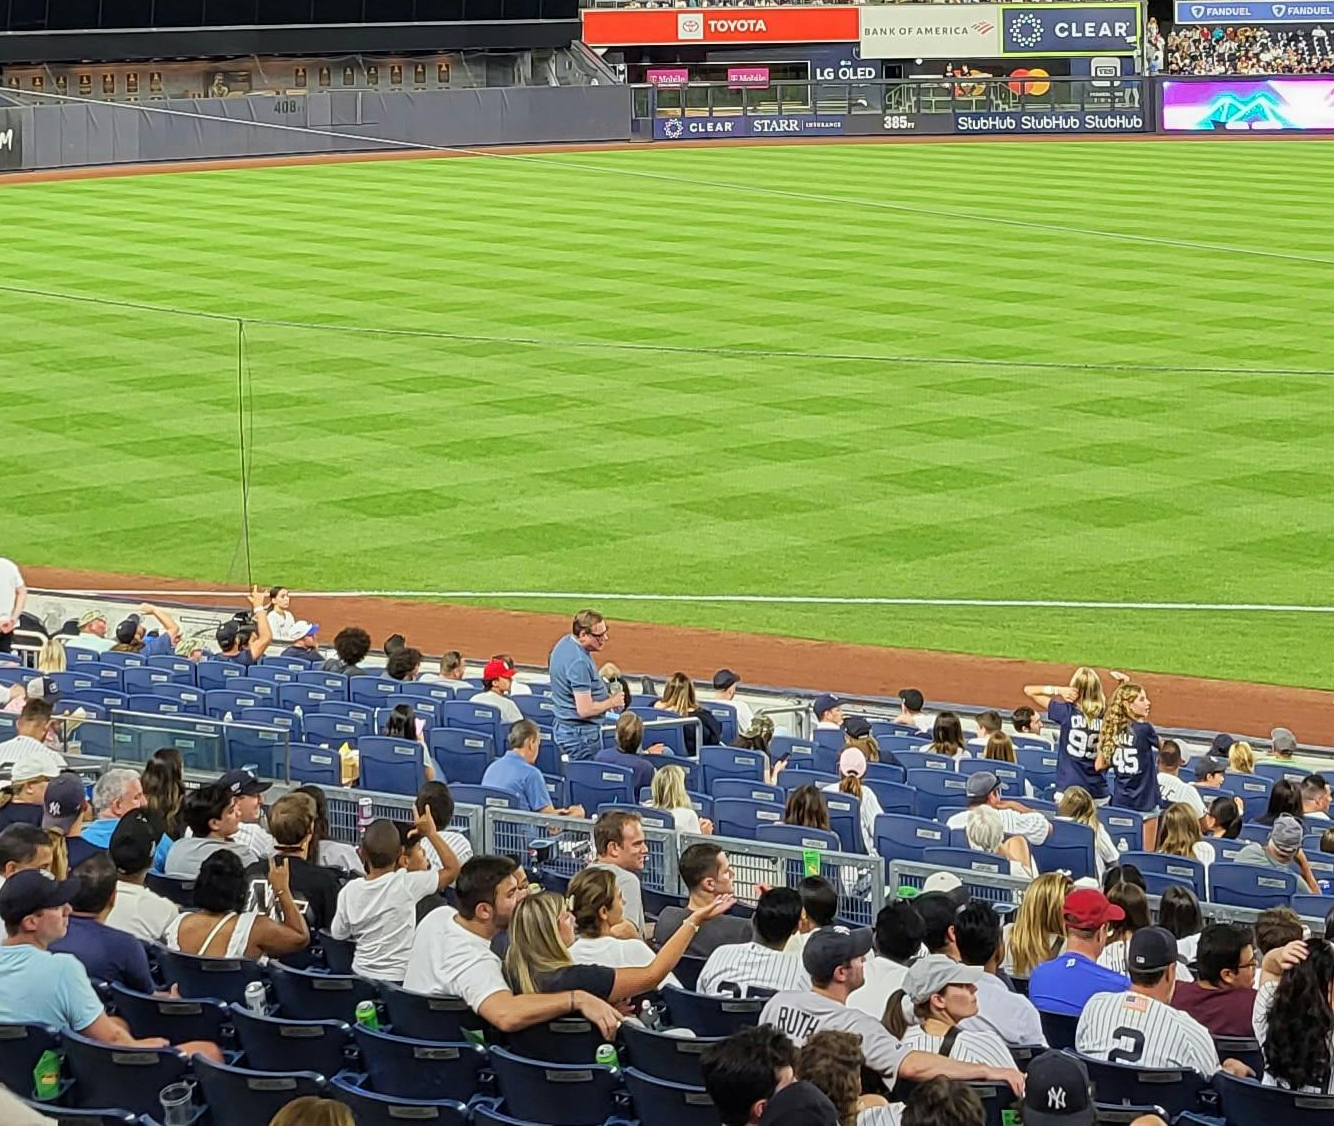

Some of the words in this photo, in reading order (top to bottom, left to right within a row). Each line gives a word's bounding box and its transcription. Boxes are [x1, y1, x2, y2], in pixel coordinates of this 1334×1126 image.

[1206, 7, 1251, 16] FANDUEL
[1287, 6, 1332, 16] FANDUEL
[708, 19, 767, 32] TOYOTA
[864, 27, 896, 36] BANK
[899, 27, 914, 36] OF
[915, 26, 969, 35] AMERICA
[1055, 23, 1127, 37] CLEAR
[816, 69, 834, 80] LG
[838, 67, 876, 79] OLED
[689, 122, 732, 132] CLEAR
[753, 120, 800, 132] STARR
[957, 114, 1016, 130] StubHub
[1021, 114, 1079, 130] StubHub
[1085, 114, 1142, 130] StubHub
[1112, 747, 1140, 774] 45
[778, 1006, 819, 1039] RUTH
[1108, 1026, 1145, 1064] 2
[1047, 1086, 1066, 1109] NY
